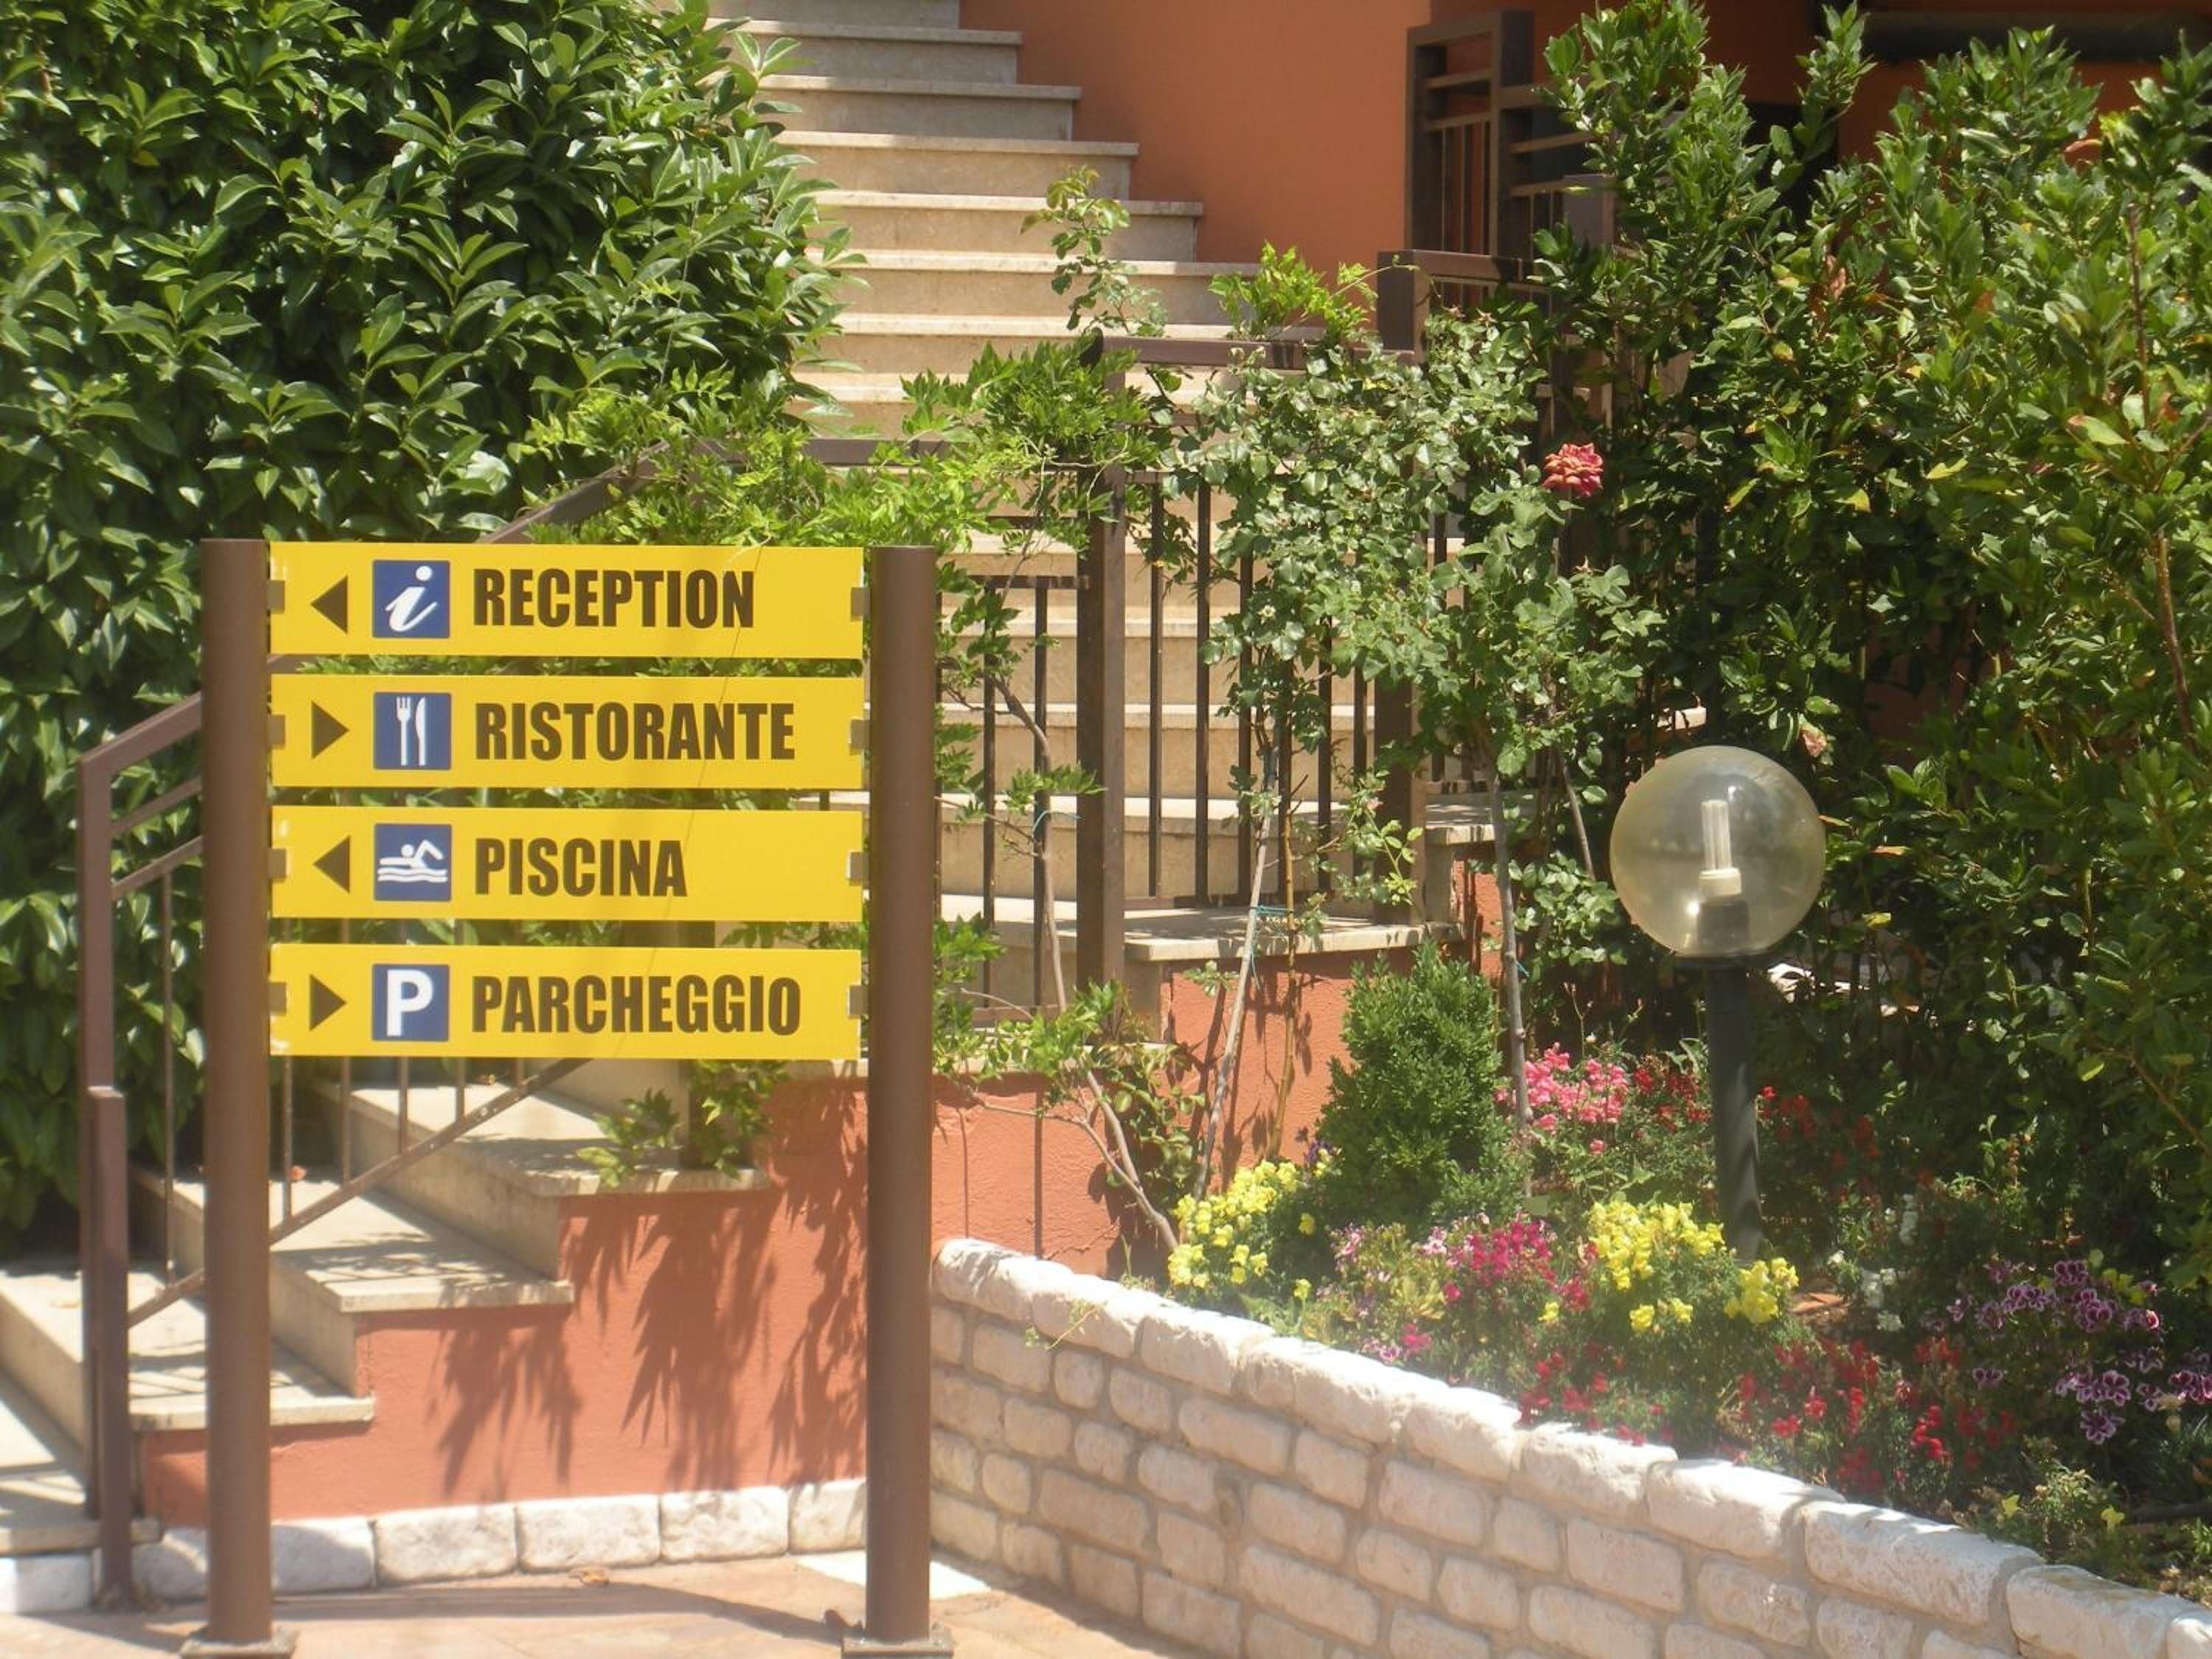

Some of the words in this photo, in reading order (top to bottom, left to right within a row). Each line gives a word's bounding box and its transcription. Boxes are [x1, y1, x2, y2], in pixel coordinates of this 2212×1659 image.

[474, 569, 753, 628] RECEPTION
[476, 702, 794, 760] RISTORANTE
[476, 838, 686, 896] PISCINA
[386, 970, 433, 1037] P
[473, 975, 799, 1035] PARCHEGGIO
